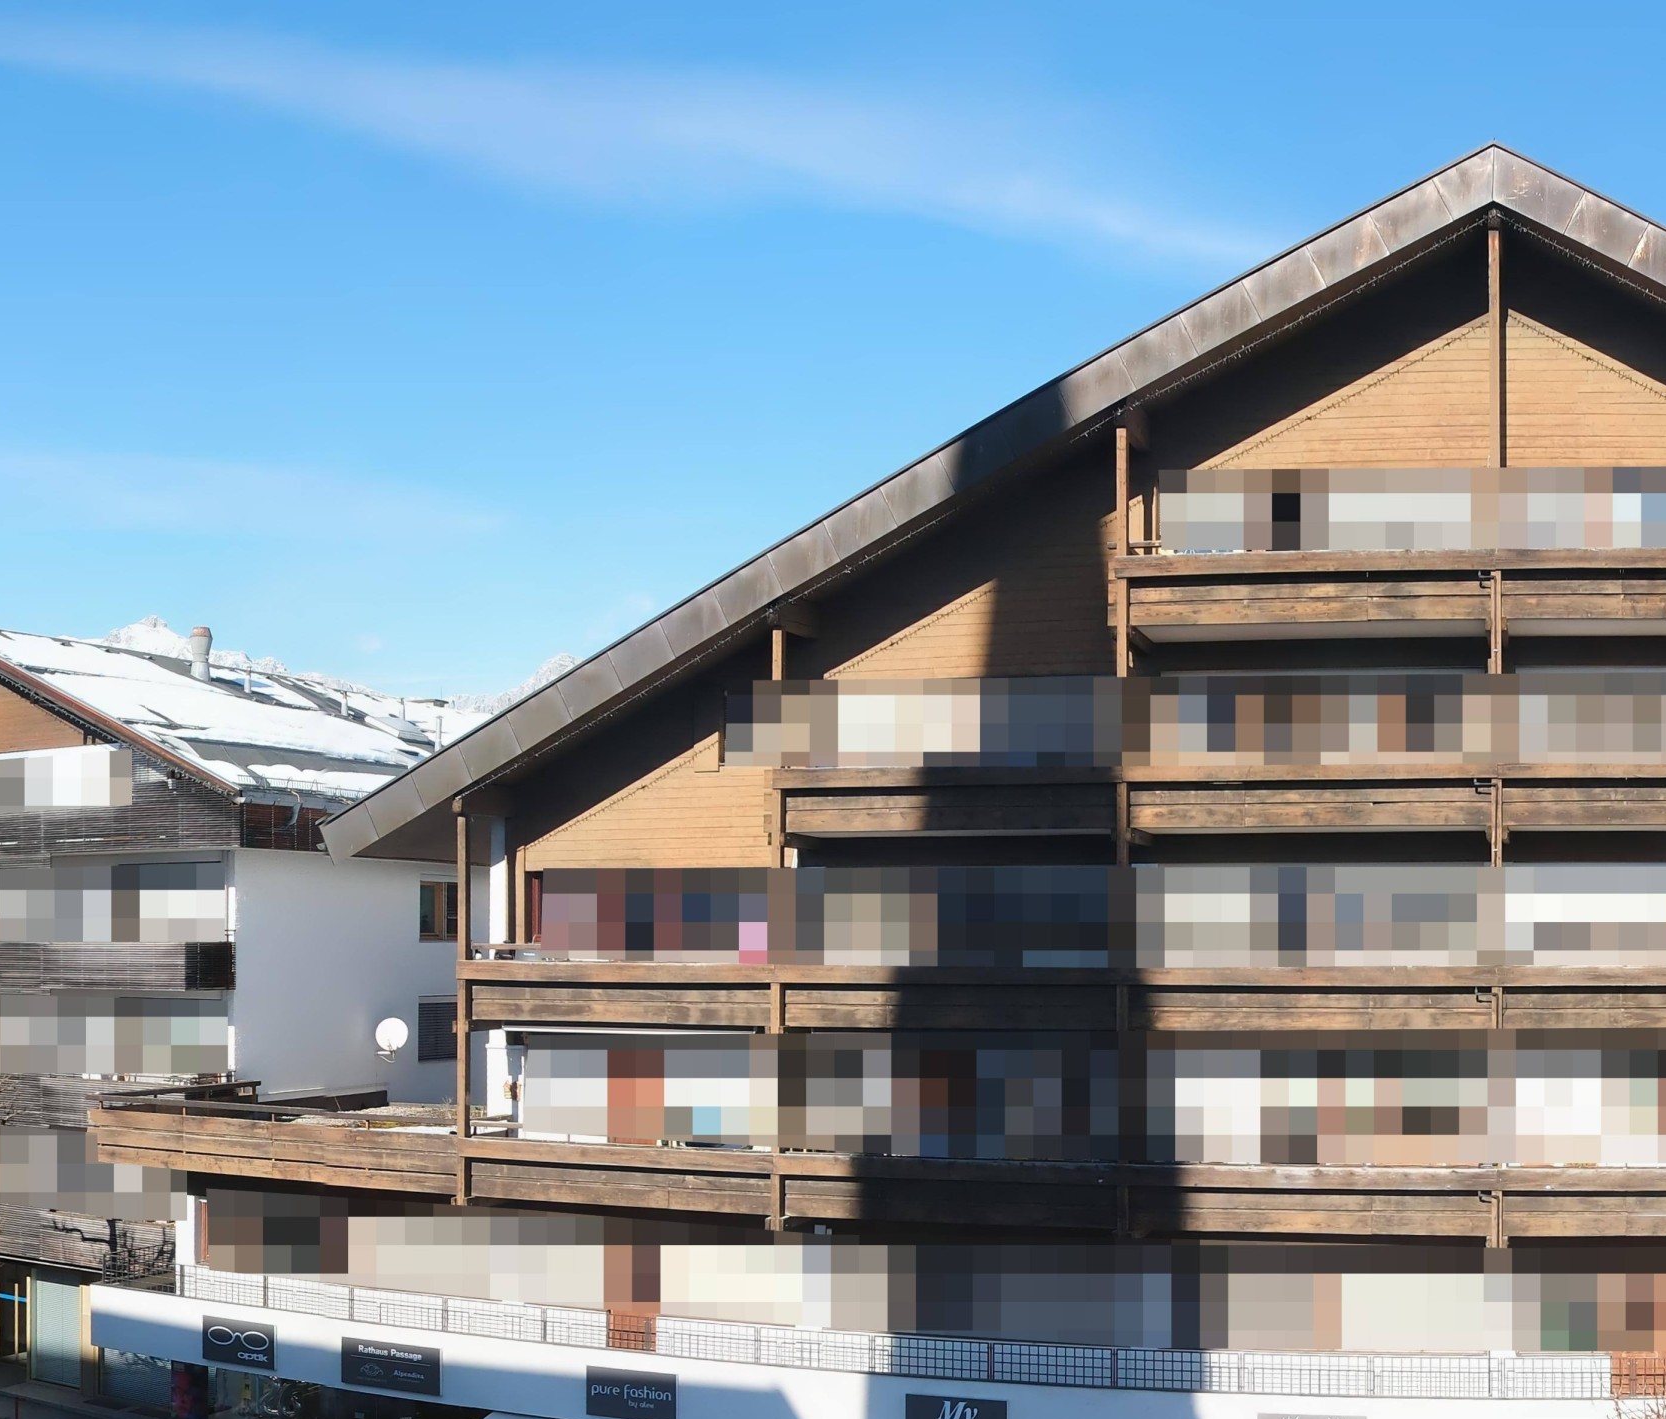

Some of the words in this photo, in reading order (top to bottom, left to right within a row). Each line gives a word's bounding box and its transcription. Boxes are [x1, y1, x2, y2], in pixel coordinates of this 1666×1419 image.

[237, 1351, 269, 1362] optik
[358, 1345, 389, 1356] Rathaus
[390, 1348, 423, 1361] Passage
[591, 1384, 620, 1396] pure
[623, 1384, 672, 1401] fashion
[628, 1400, 638, 1408] by
